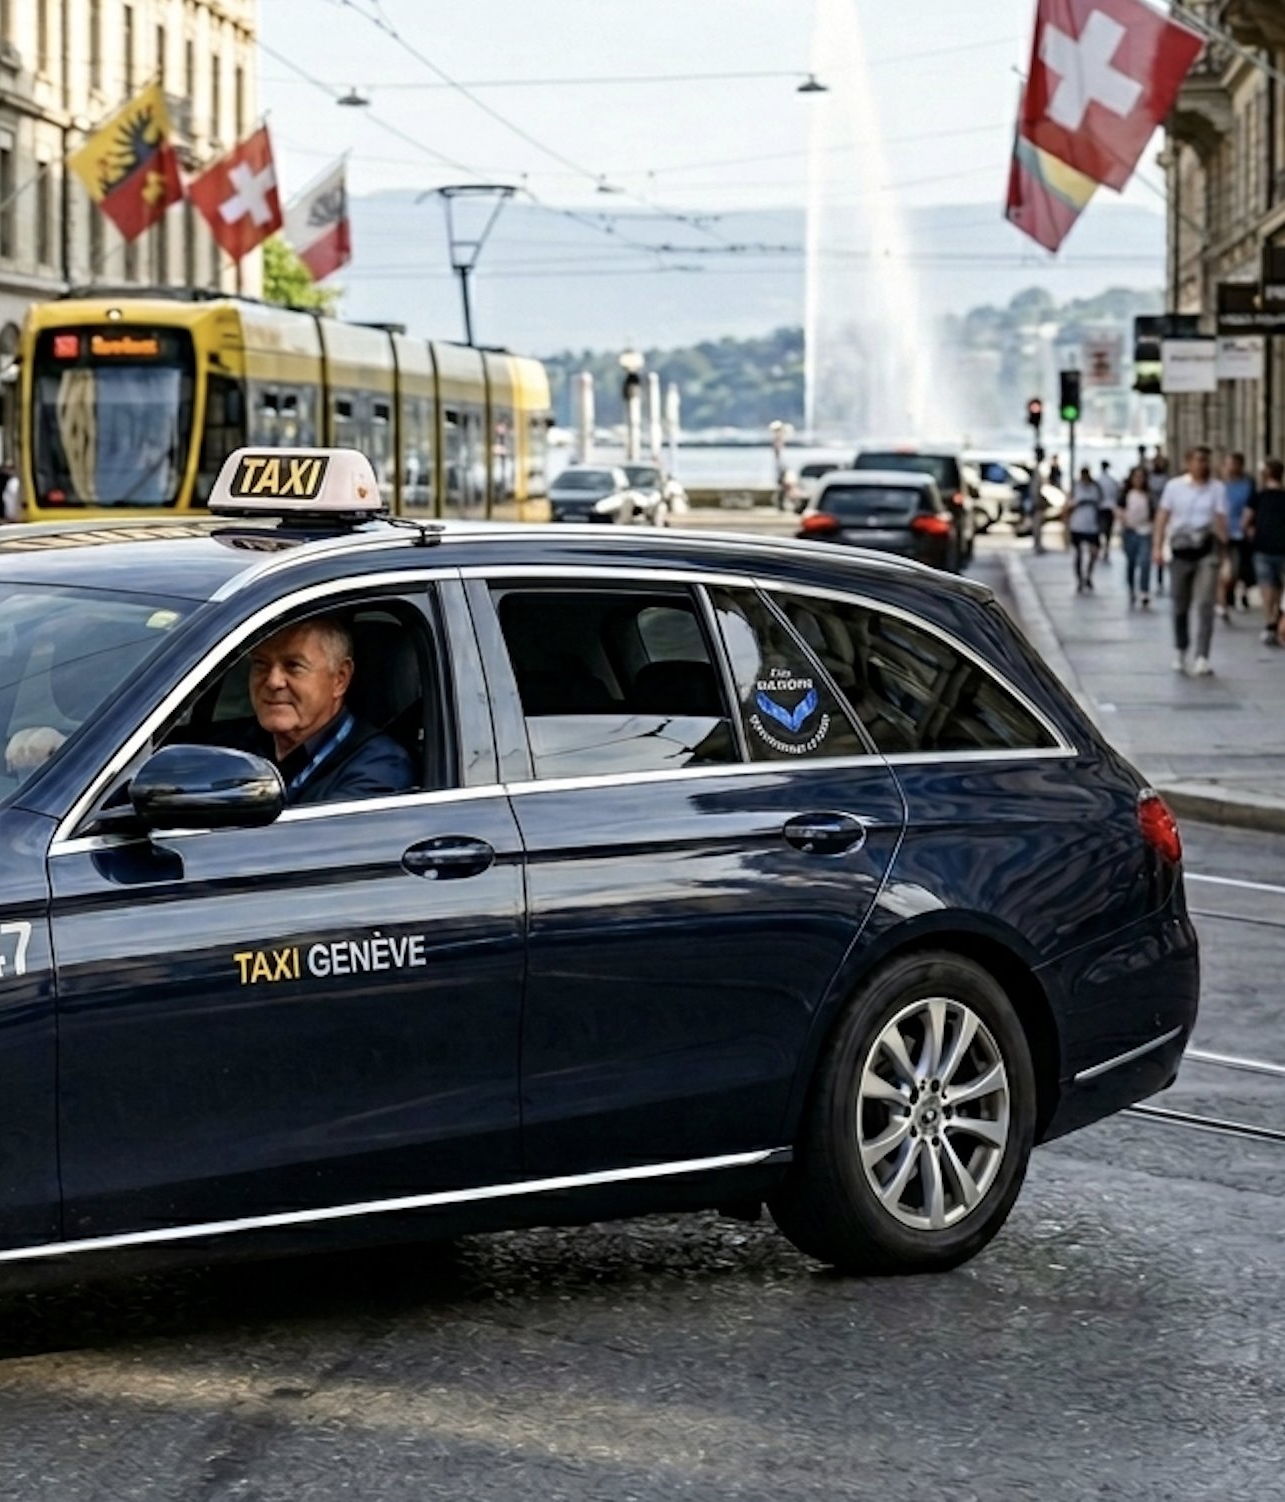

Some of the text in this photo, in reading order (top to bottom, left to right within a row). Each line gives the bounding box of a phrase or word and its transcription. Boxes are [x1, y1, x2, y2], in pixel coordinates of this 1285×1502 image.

[240, 457, 322, 496] TAXI
[233, 930, 427, 985] TAXI GENÈVE
